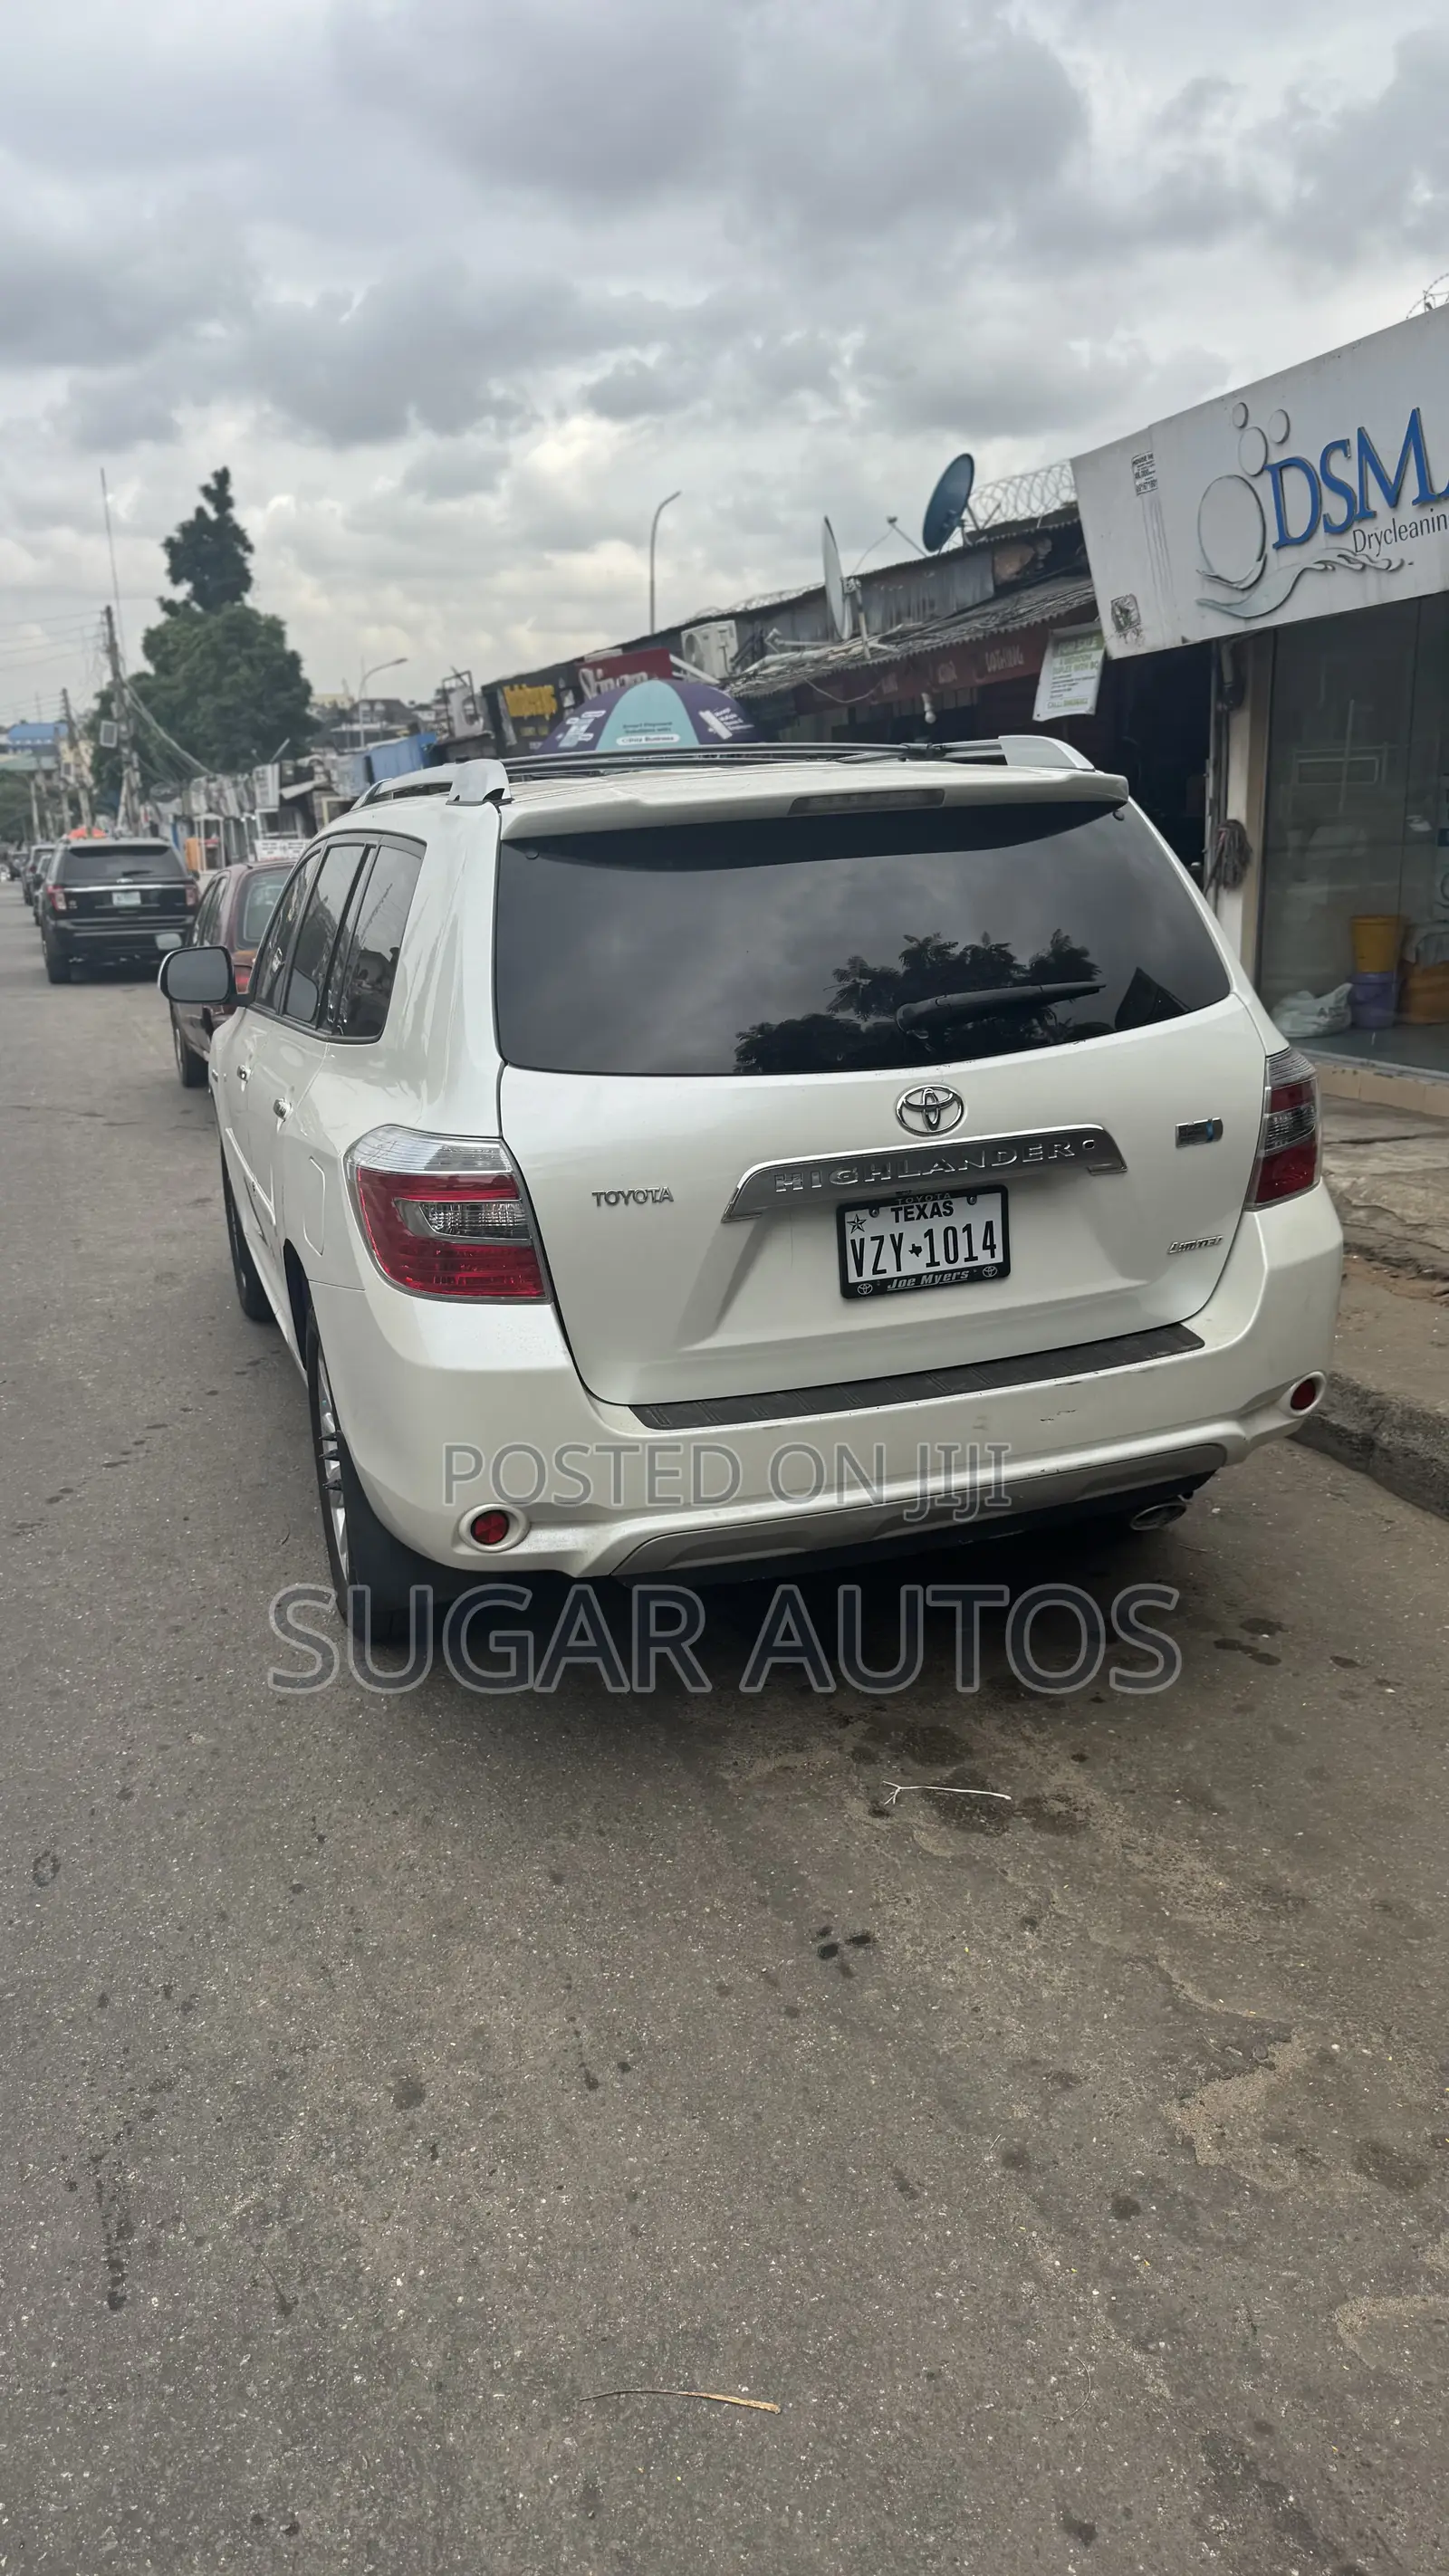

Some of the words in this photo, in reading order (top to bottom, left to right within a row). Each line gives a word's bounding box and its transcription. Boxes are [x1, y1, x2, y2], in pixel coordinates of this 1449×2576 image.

[1263, 407, 1449, 550] DSM
[1352, 508, 1449, 557] Drycleanin
[773, 1139, 1076, 1192] HIGHLANDER
[591, 1186, 675, 1207] TOYOTA
[890, 1201, 955, 1223] TEXAS
[895, 1192, 952, 1206] TOYOTA
[850, 1232, 904, 1278] VZY
[924, 1220, 997, 1269] 1014
[887, 1277, 916, 1290] Joe
[919, 1269, 970, 1286] Myers
